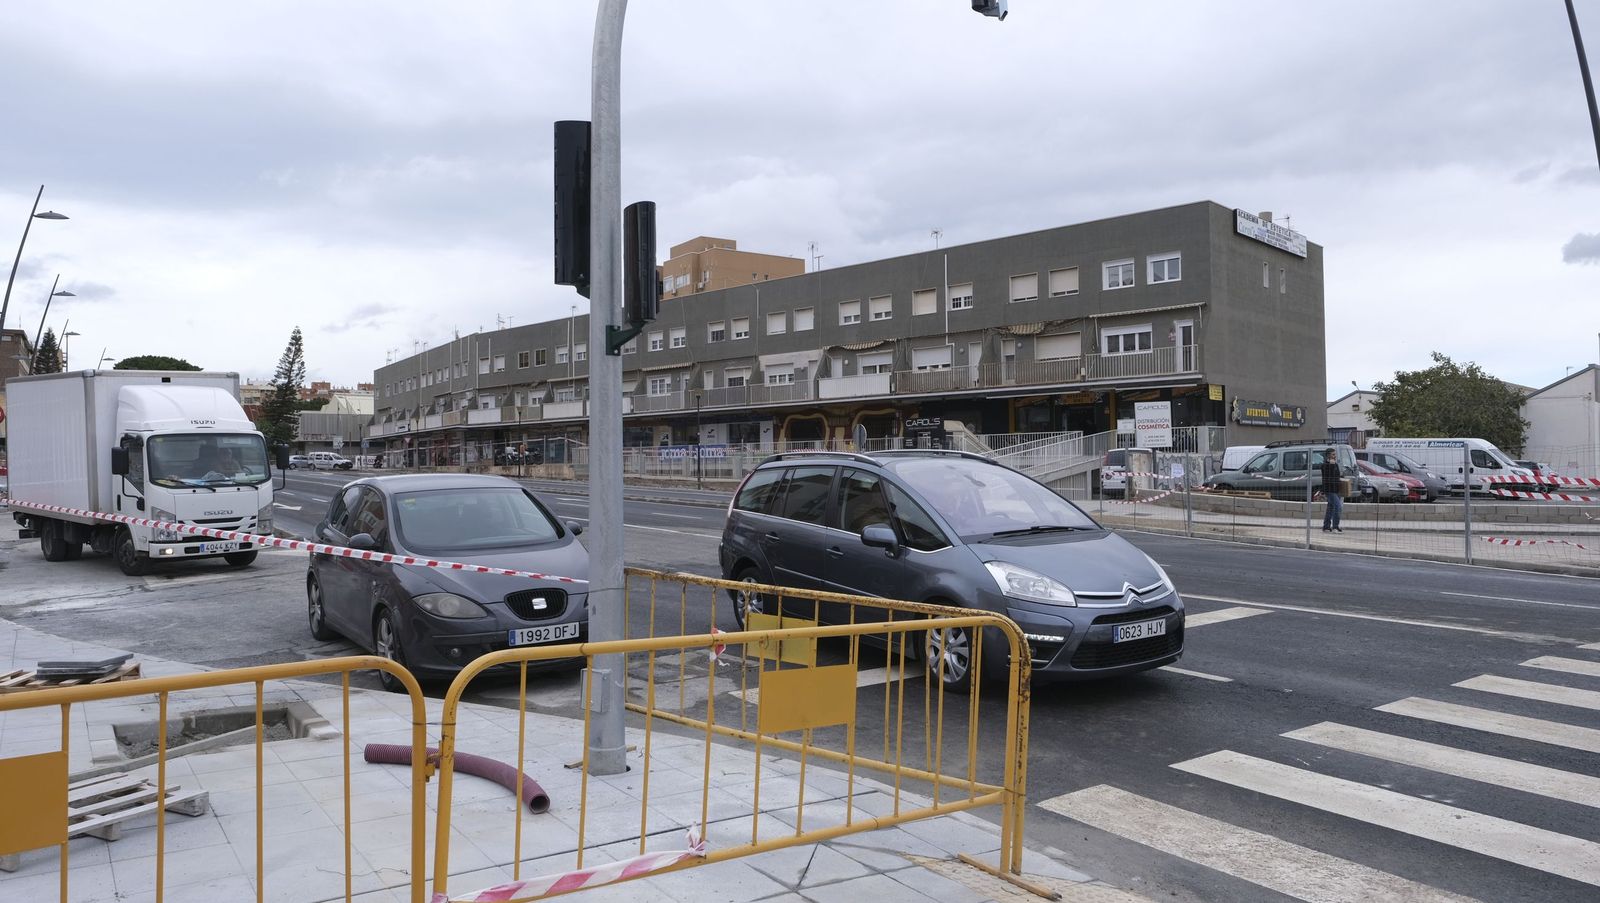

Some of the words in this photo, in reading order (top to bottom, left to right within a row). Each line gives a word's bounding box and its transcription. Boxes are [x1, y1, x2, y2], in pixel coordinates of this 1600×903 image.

[1237, 210, 1259, 225] ACADEMIA
[1429, 440, 1464, 449] Almericar
[206, 543, 223, 551] 4044
[519, 628, 550, 643] 1992
[554, 623, 577, 639] DFJ
[1119, 624, 1142, 640] 0623
[1147, 620, 1164, 636] HJY
